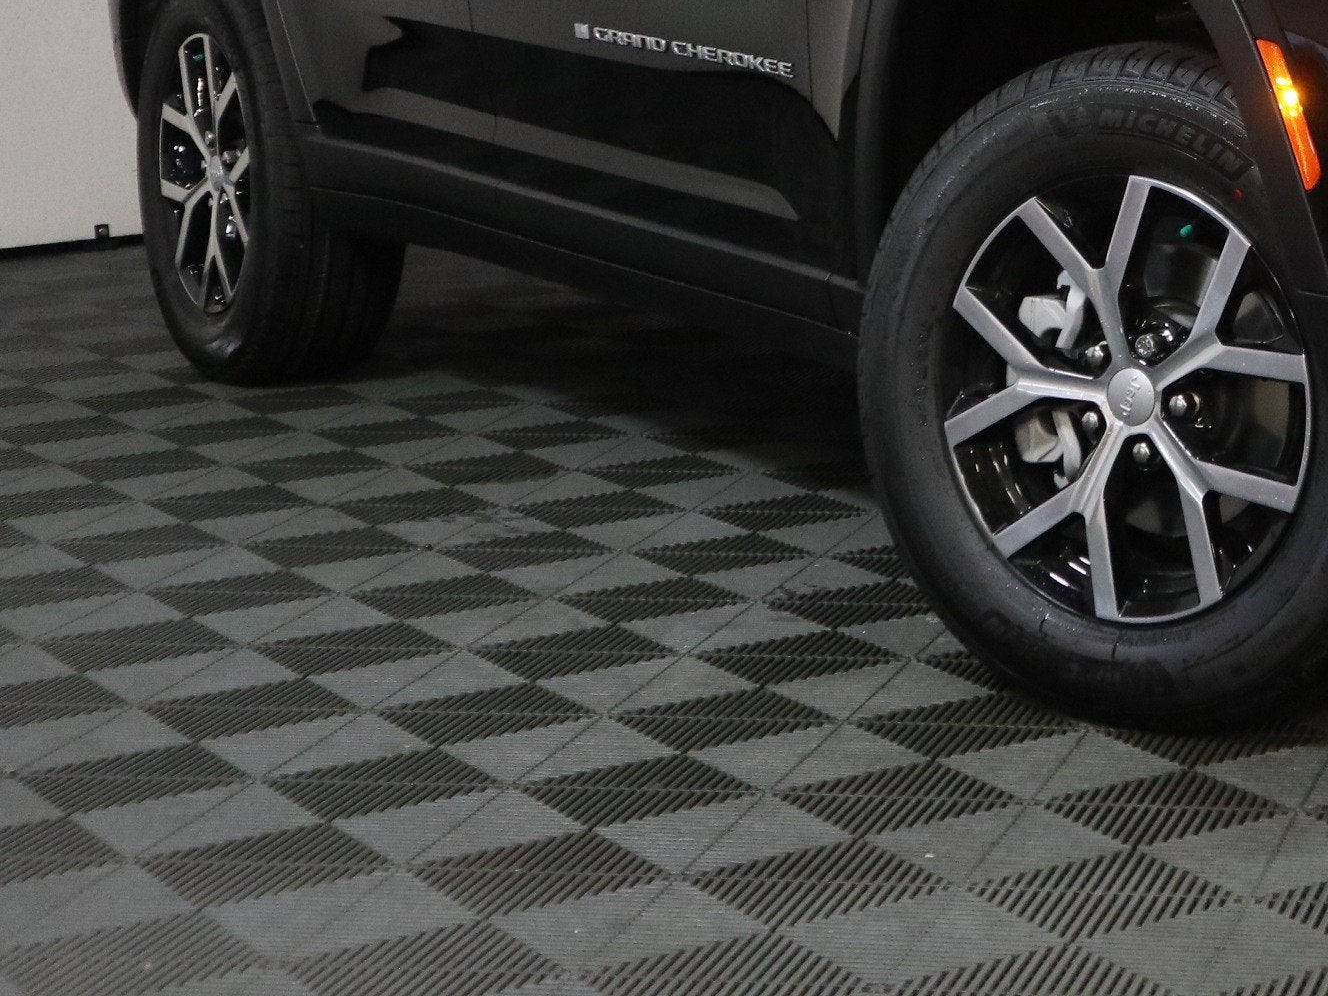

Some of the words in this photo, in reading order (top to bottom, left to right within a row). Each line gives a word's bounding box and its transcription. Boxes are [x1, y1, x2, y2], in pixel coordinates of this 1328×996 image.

[593, 26, 667, 53] GRAND
[670, 40, 795, 79] CHEROKEE
[1099, 107, 1246, 174] MICHELIN
